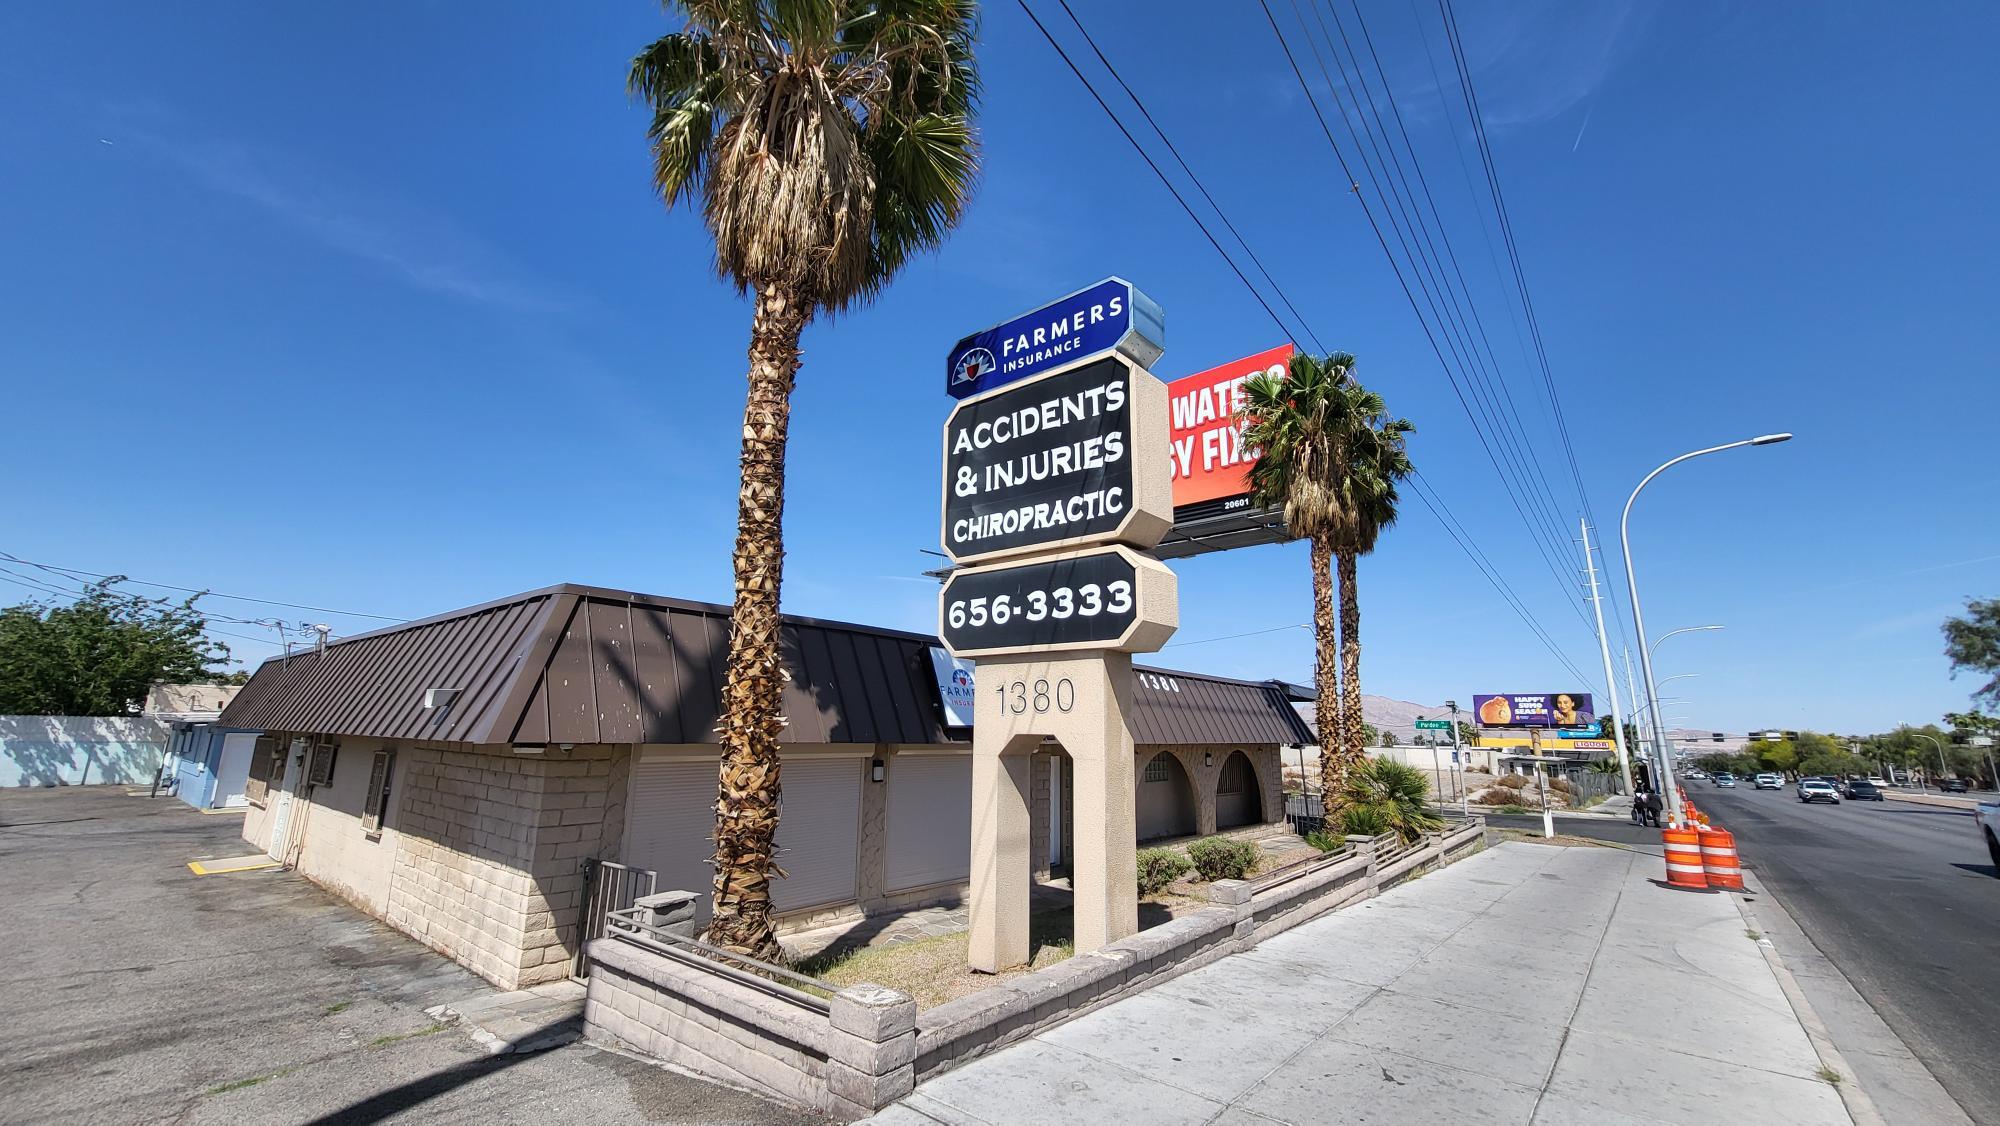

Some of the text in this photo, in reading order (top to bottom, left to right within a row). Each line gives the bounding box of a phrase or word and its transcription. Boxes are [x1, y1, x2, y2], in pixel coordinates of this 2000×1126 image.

[1003, 296, 1123, 357] FARMERS
[1003, 336, 1081, 373] INSURANCE
[952, 381, 1125, 455] ACCIDENTS
[954, 431, 1124, 498] & INJURIES
[953, 487, 1124, 543] CHIROPRACTIC
[1224, 497, 1249, 510] 20601
[949, 580, 1132, 629] 656-3333
[996, 677, 1074, 716] 1380
[1139, 673, 1180, 693] 1380
